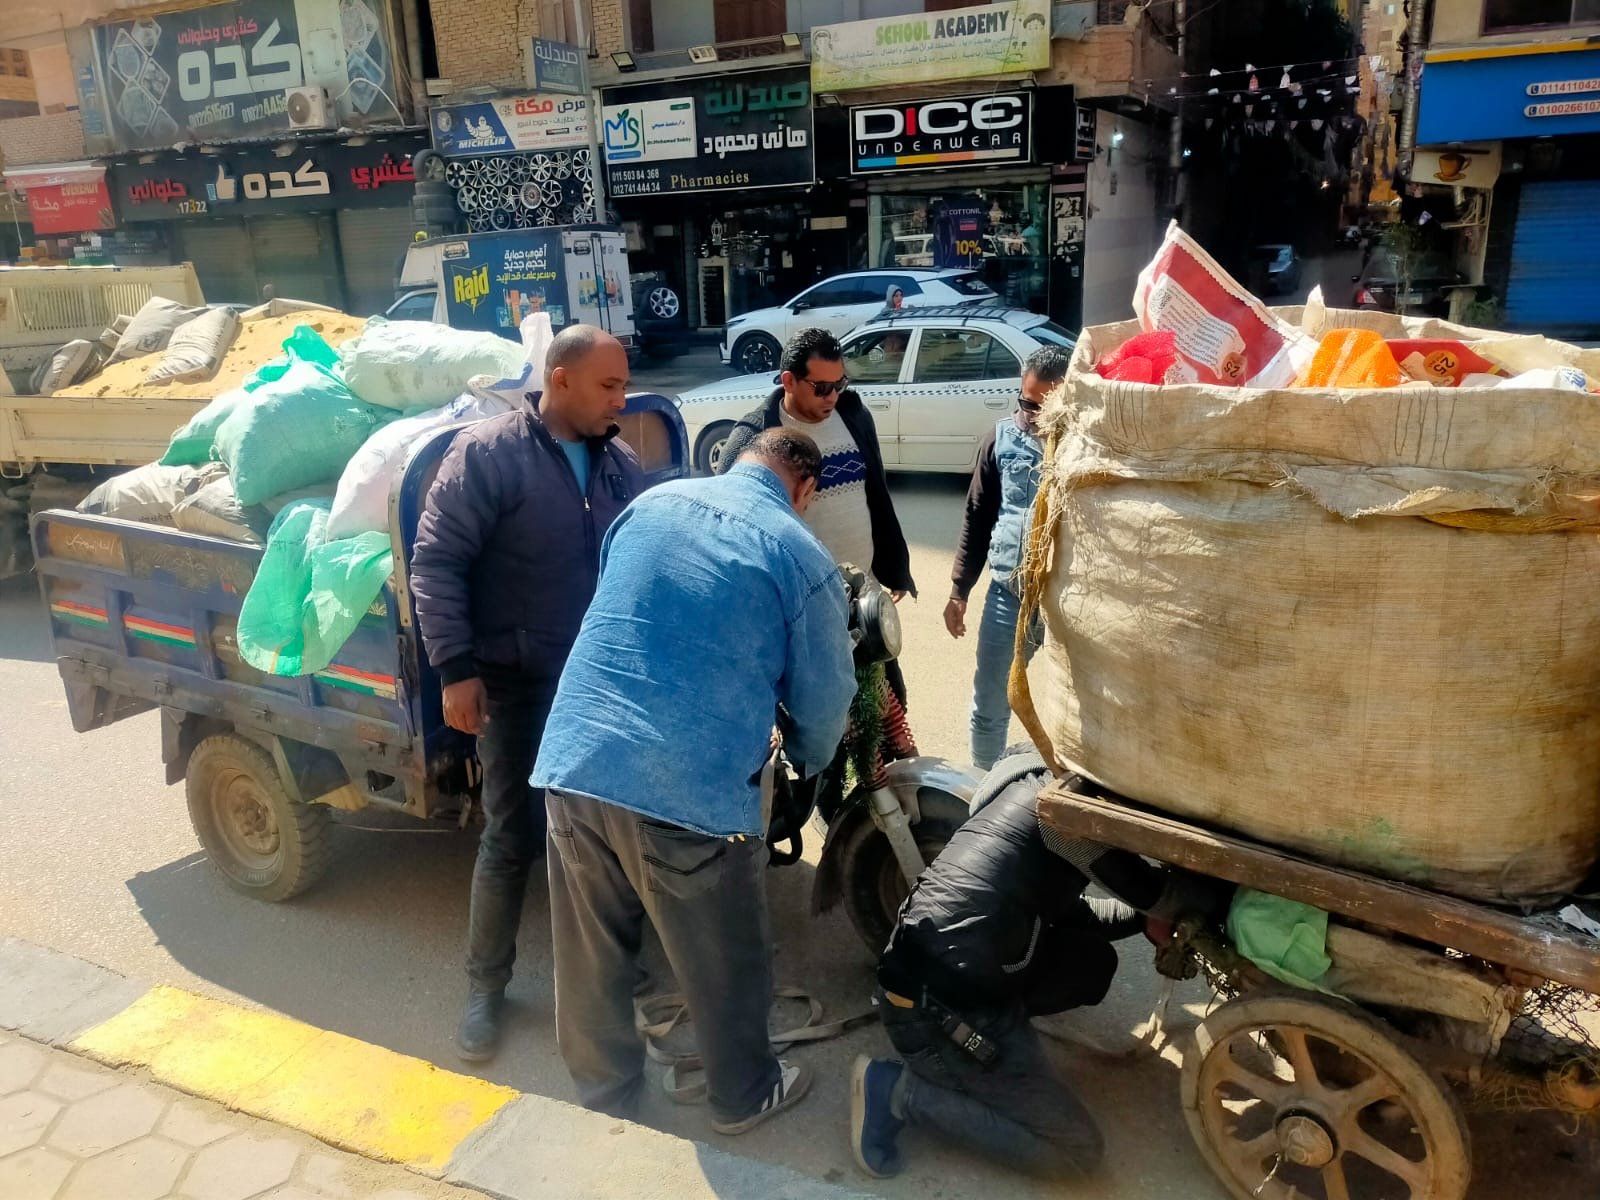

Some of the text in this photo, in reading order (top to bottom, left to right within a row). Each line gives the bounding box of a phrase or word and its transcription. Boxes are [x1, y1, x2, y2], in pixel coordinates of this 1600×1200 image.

[875, 10, 1010, 46] SCHOOL ACADEMY
[177, 18, 302, 101] كده
[535, 40, 579, 68] صيدلية
[515, 97, 554, 116] مكة
[704, 81, 809, 123] صيدلية
[855, 96, 1023, 141] DICE
[458, 136, 507, 150] MICHELIN
[703, 132, 759, 159] محمود
[243, 159, 330, 199] كده
[671, 170, 750, 190] Pharmacies
[178, 200, 208, 215] 17322
[949, 207, 982, 216] COTTONIL
[503, 248, 525, 261] حماية
[955, 239, 982, 256] 10%
[503, 259, 548, 272] بحجم جديد
[453, 265, 490, 303] Raid
[1224, 361, 1241, 378] 25
[1434, 357, 1455, 375] 25
